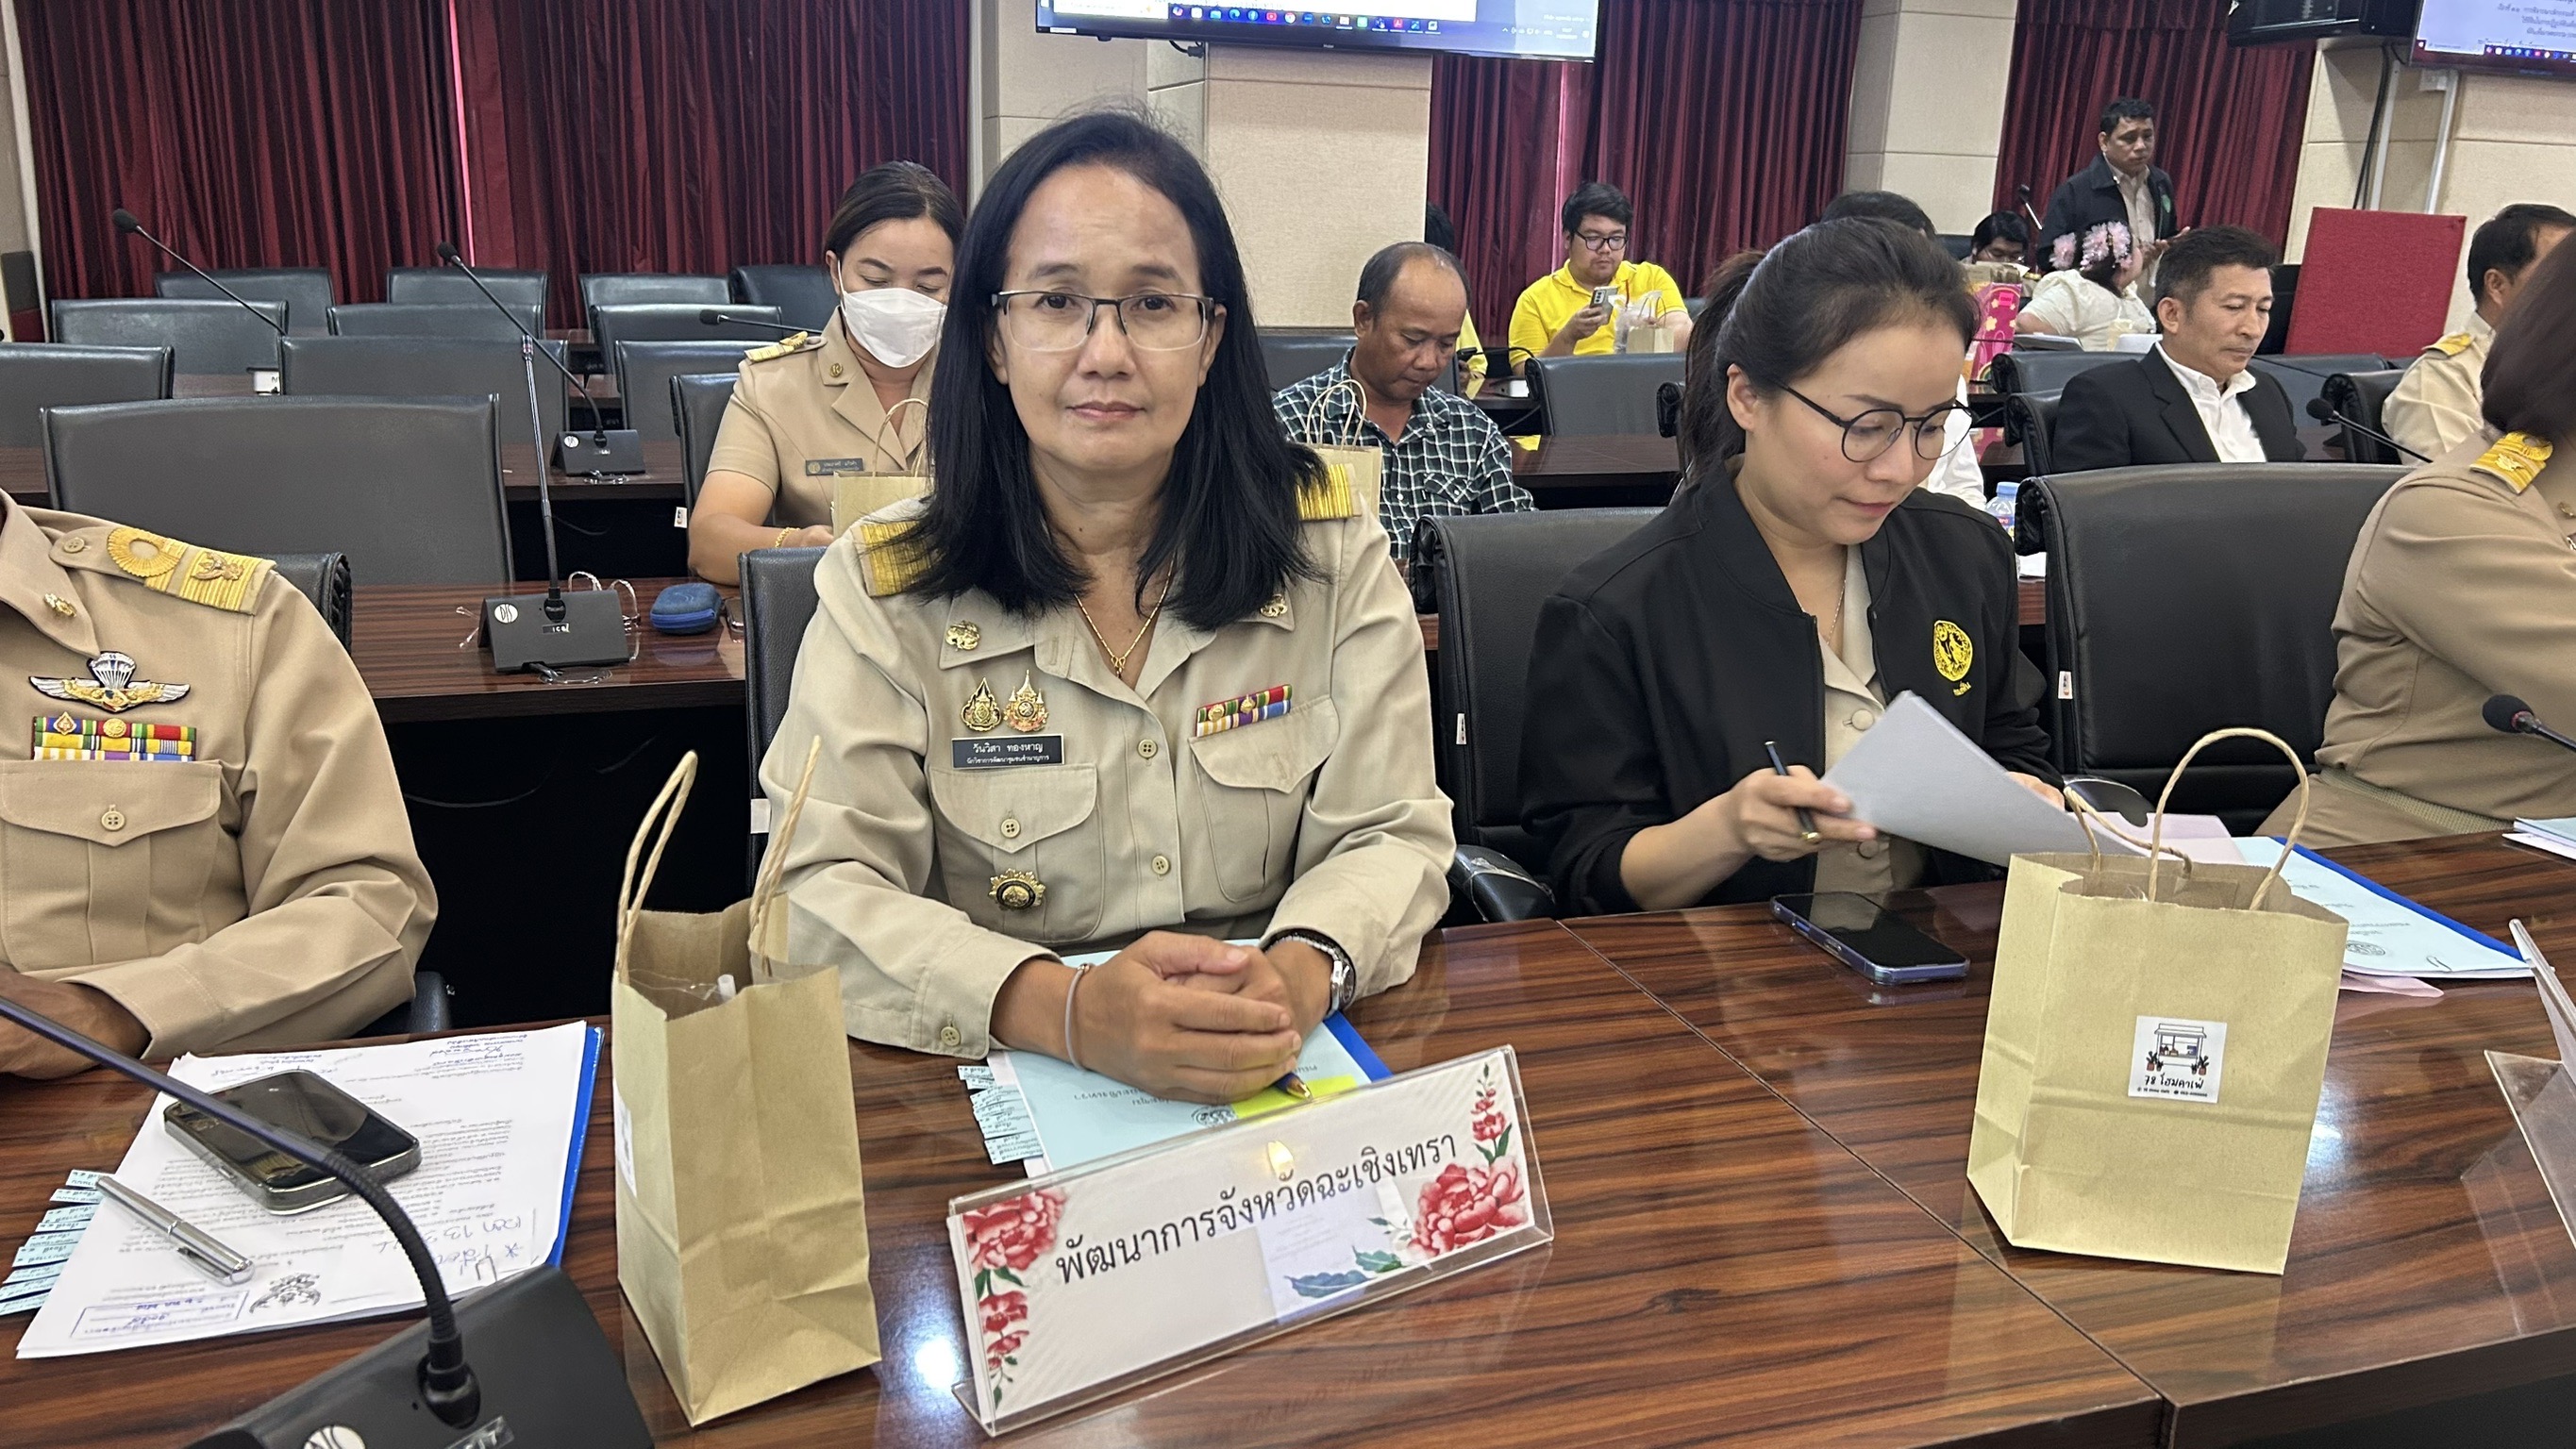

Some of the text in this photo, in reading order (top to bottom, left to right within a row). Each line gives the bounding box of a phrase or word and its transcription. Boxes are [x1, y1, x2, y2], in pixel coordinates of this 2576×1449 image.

[973, 741, 1044, 753] วันวิสา ทองหาญ
[2145, 1073, 2204, 1090] 78 โฮมคาเฟ่
[1056, 1131, 1456, 1285] พัฒนาการจังหวัดฉะเชิงเทรา
